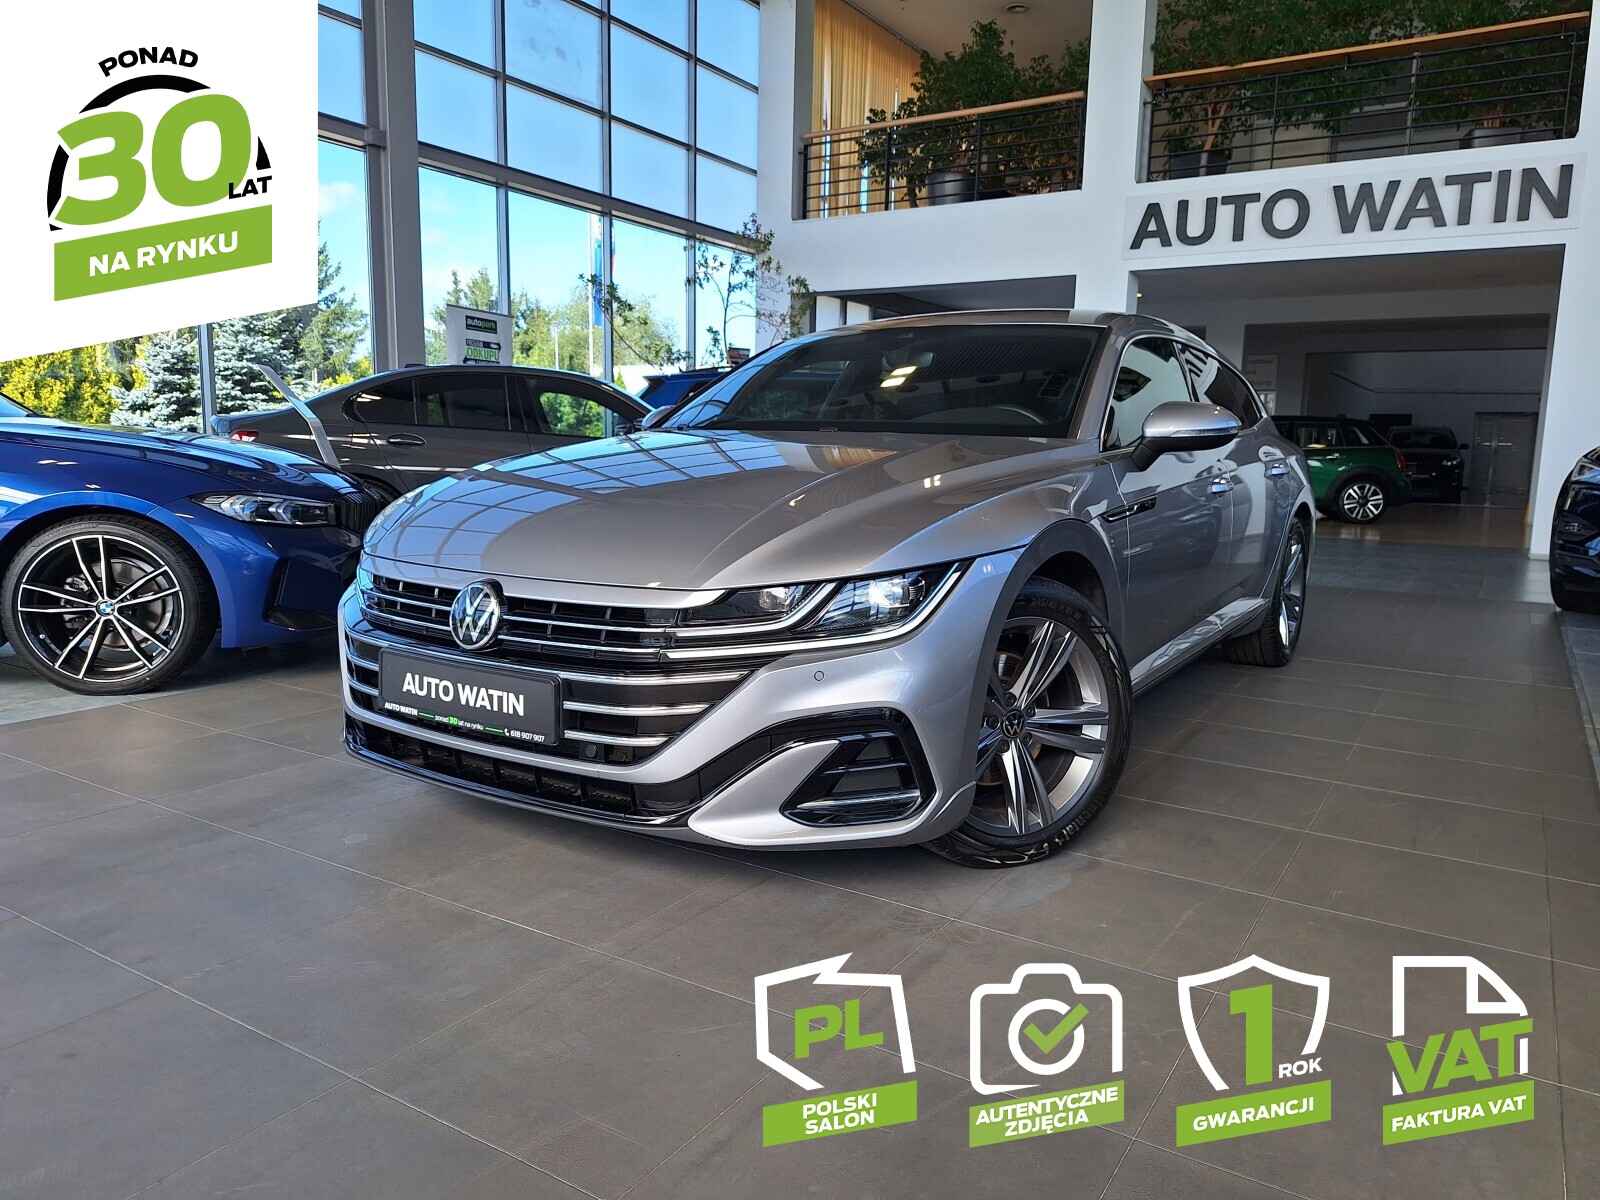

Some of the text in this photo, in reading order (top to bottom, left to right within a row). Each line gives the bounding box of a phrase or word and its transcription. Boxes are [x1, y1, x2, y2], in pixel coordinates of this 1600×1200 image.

[1129, 163, 1574, 250] AUTO WATIN
[467, 318, 496, 328] autopark
[467, 347, 499, 361] ODKUPU
[402, 672, 524, 717] AUTO WATIN
[384, 701, 418, 717] AUTO WATIN
[434, 714, 448, 724] ponad
[448, 715, 458, 725] 30
[510, 729, 545, 743] 618 907 907
